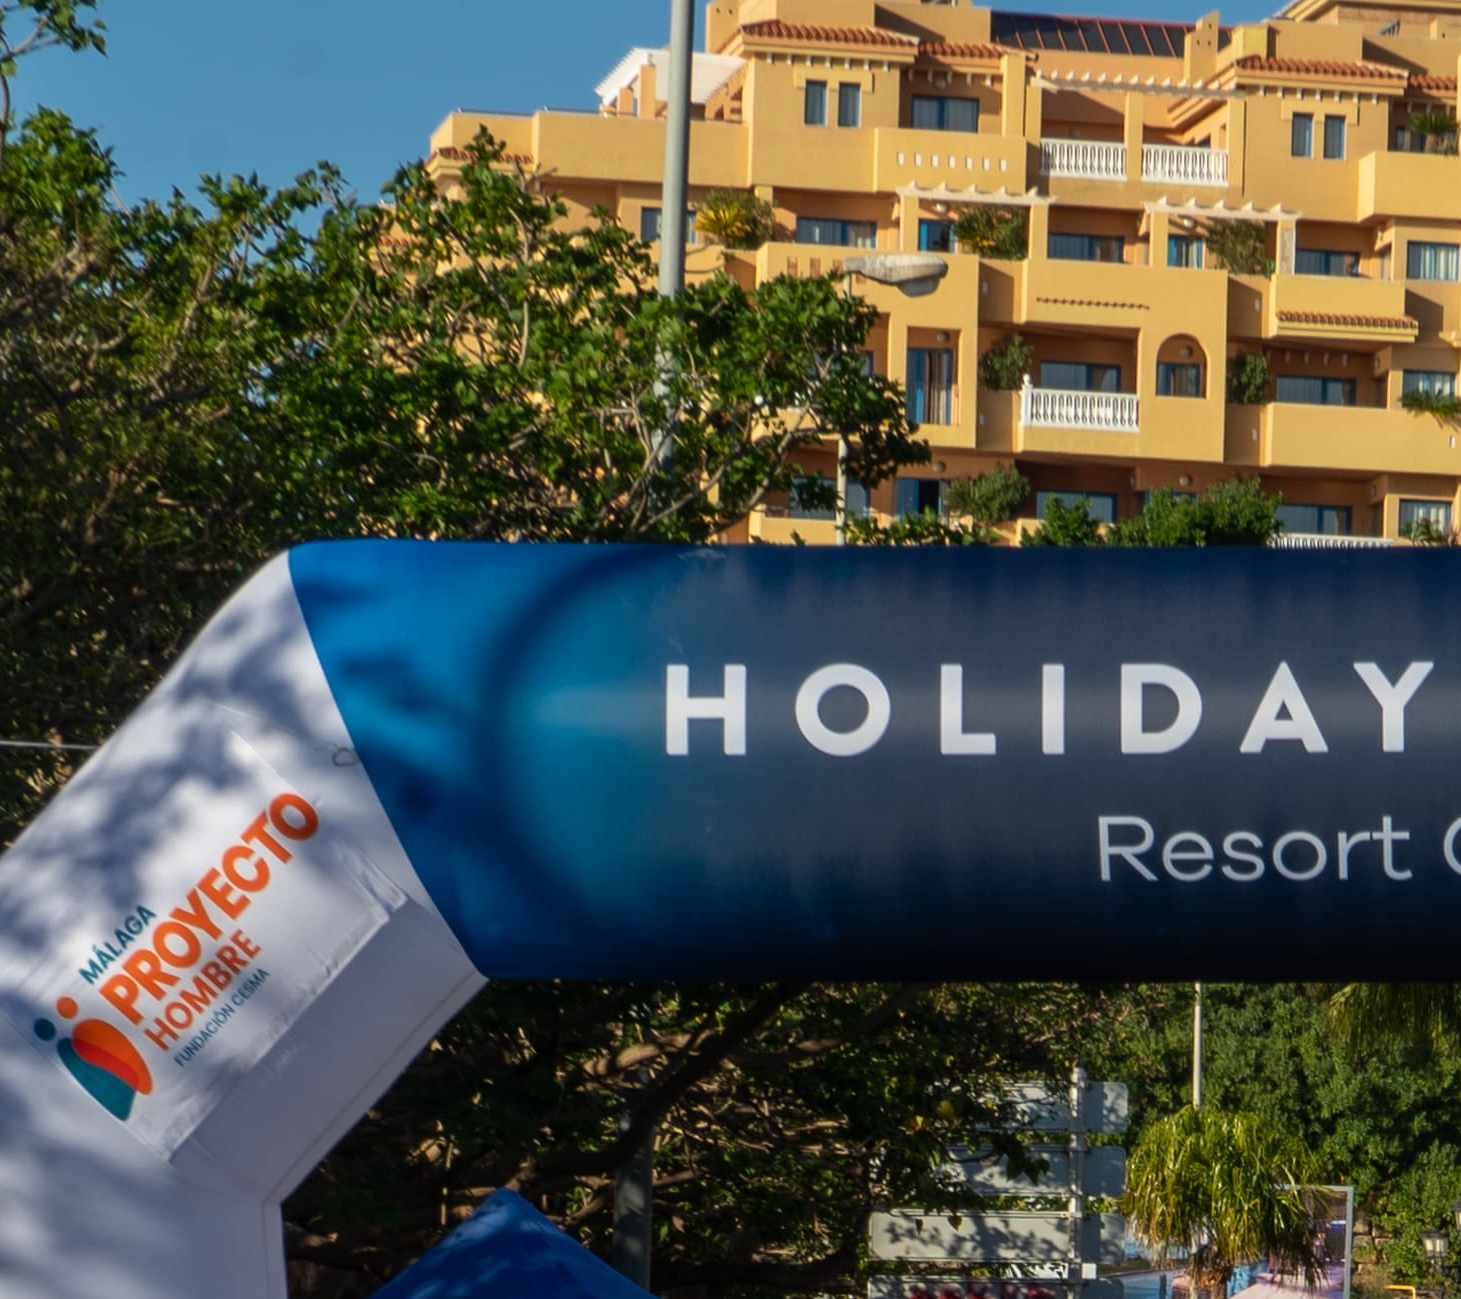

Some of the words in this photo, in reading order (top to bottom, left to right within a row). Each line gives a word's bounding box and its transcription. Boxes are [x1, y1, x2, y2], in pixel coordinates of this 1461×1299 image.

[665, 660, 1434, 756] HOLIDAY
[1098, 814, 1413, 882] Resort
[78, 904, 158, 986] MÁLAGA
[98, 792, 320, 1027] PROYECTO
[143, 928, 263, 1053] HOMBRE
[173, 1002, 236, 1068] FUNDACIÓN
[231, 967, 271, 1008] CESMA
